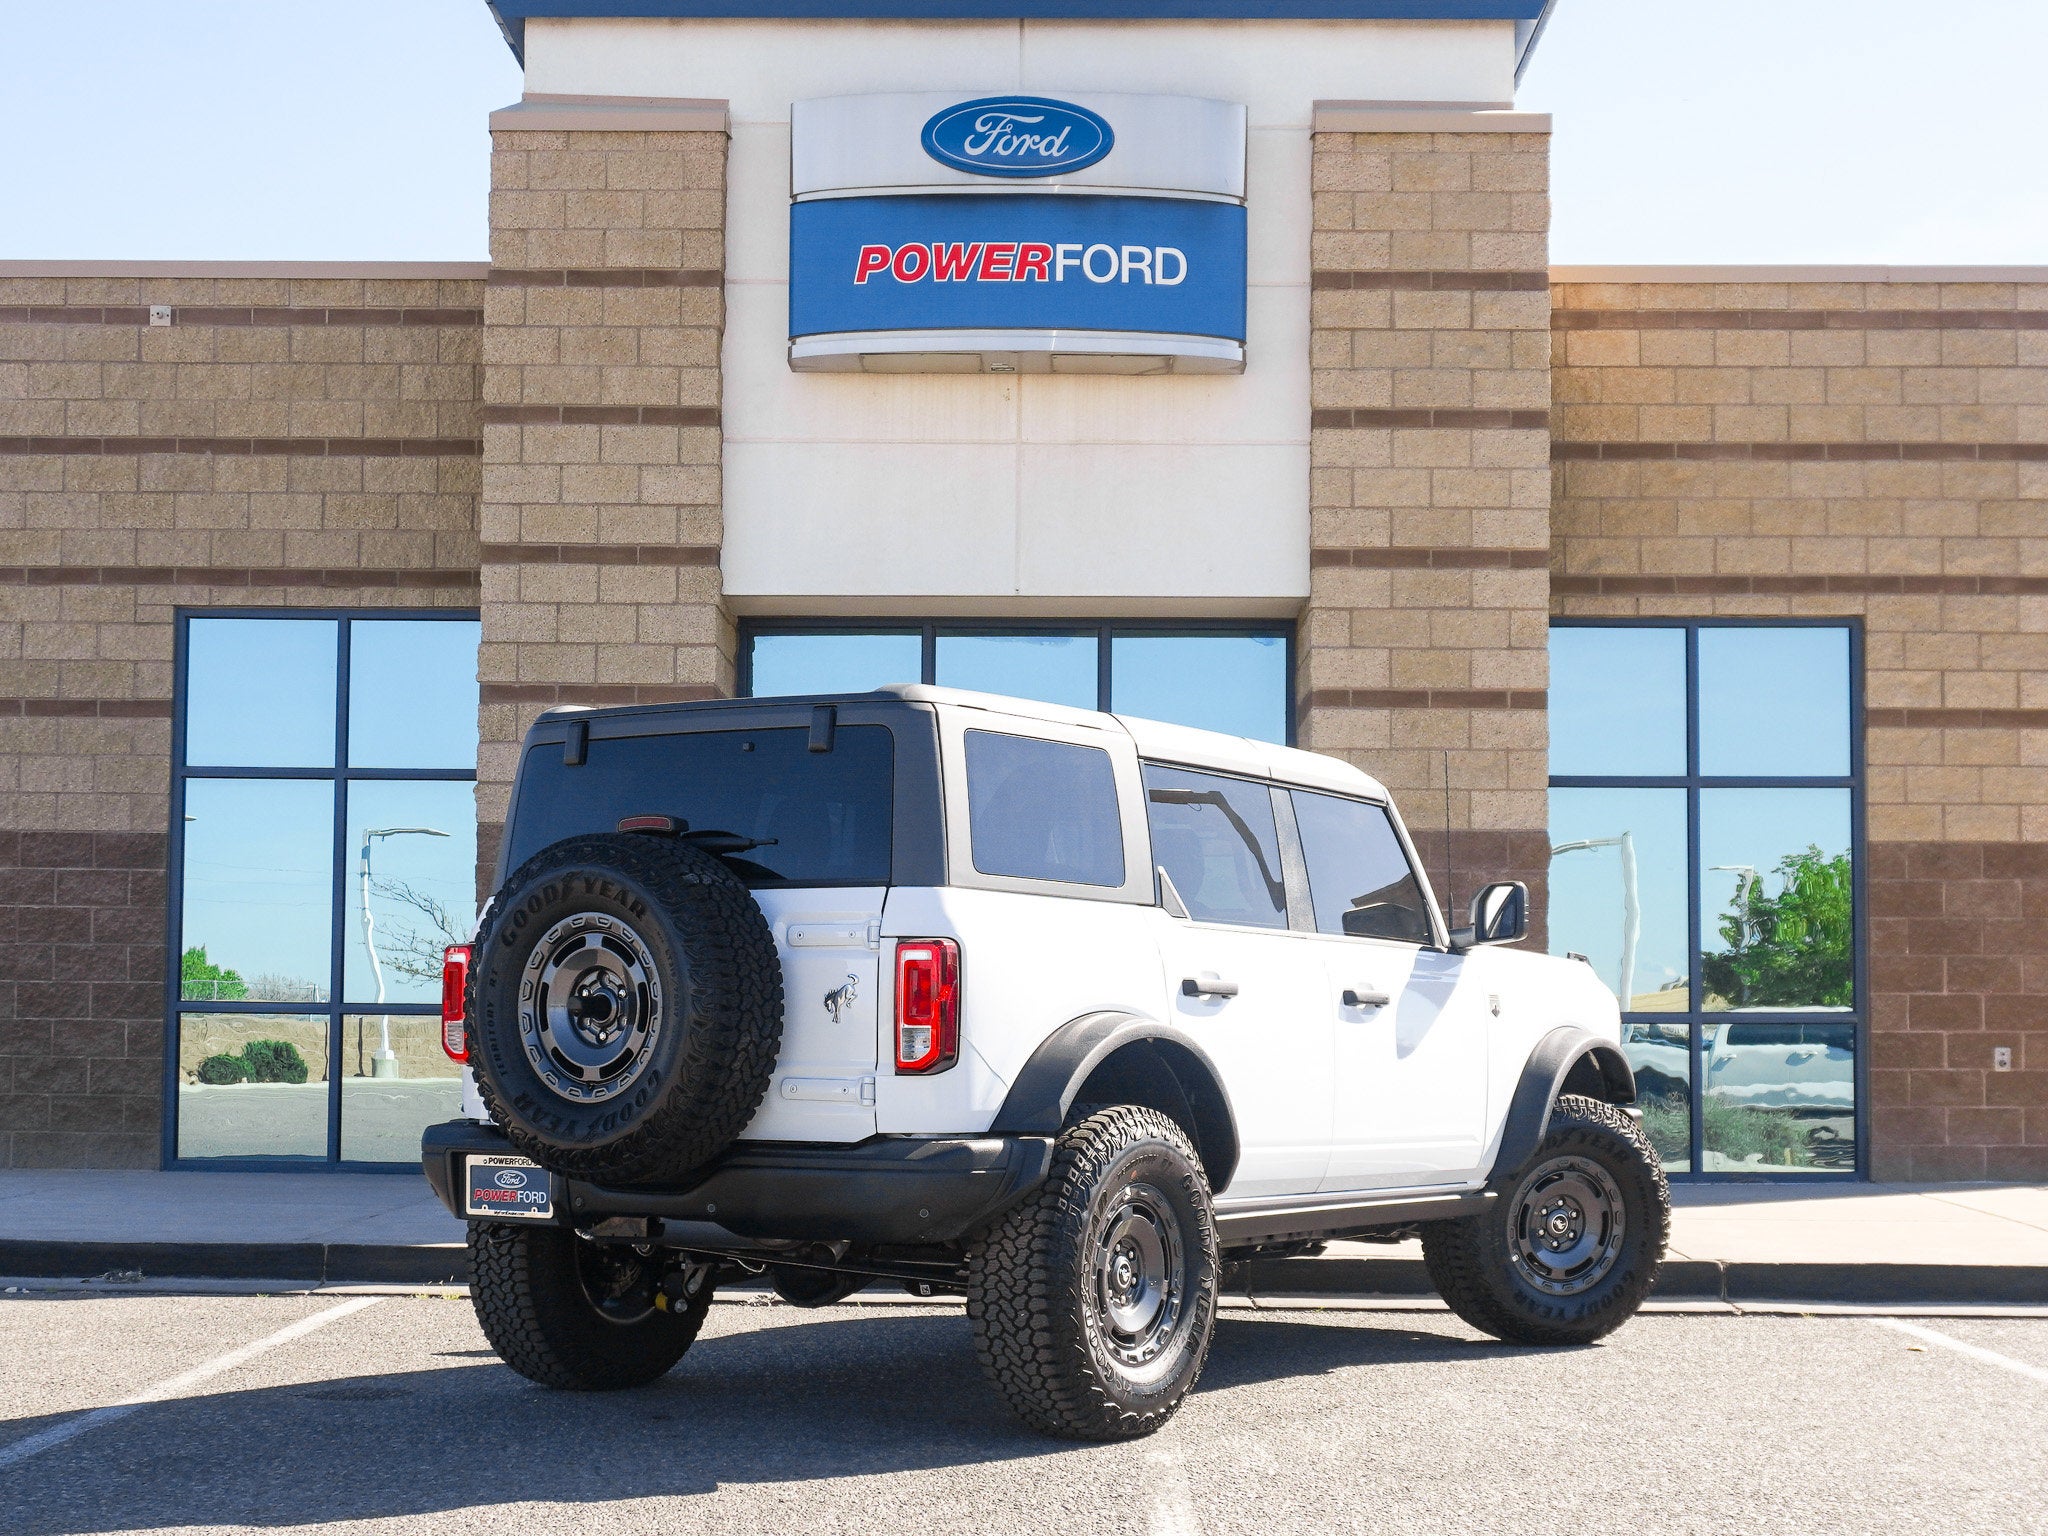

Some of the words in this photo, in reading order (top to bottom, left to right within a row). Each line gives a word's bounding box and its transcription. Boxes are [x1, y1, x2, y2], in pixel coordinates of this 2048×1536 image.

[963, 112, 1072, 157] Ford
[853, 241, 1188, 286] POWERFORD
[500, 1172, 521, 1185] Ford
[474, 1188, 547, 1204] POWERFORD
